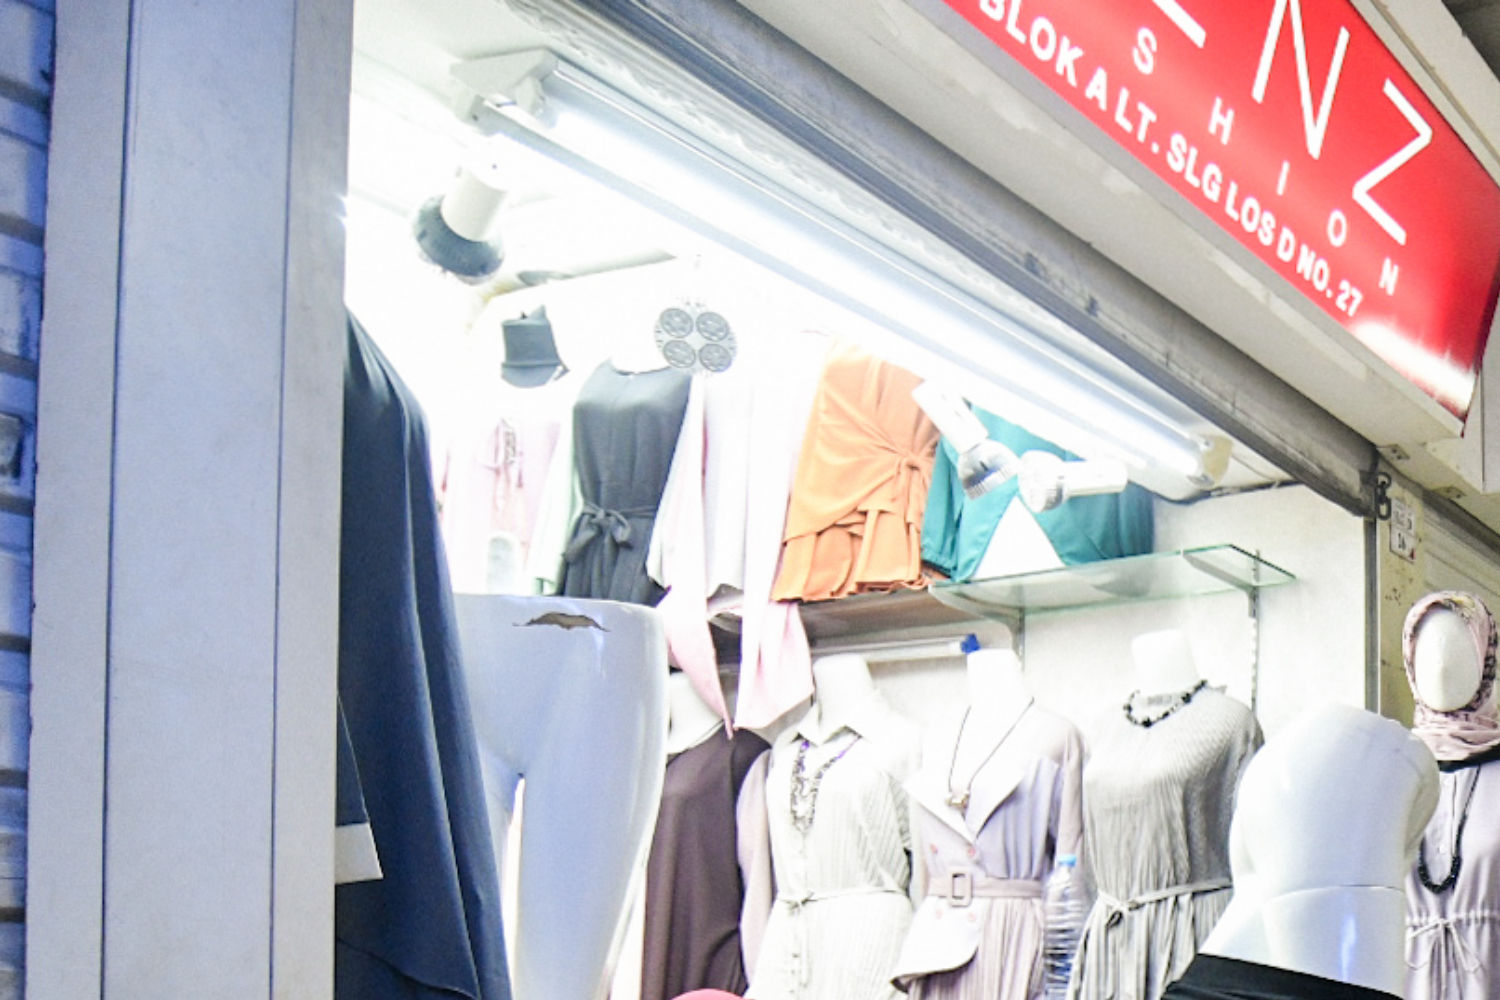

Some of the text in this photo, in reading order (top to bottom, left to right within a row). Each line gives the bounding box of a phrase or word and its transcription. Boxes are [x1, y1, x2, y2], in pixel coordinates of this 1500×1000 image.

[1085, 66, 1107, 112] A
[1114, 87, 1160, 154] LT.
[1166, 132, 1223, 203] SLG
[1225, 180, 1277, 247] LOS
[1276, 225, 1296, 263] D
[1296, 243, 1333, 299] NO.
[1335, 279, 1364, 318] 27
